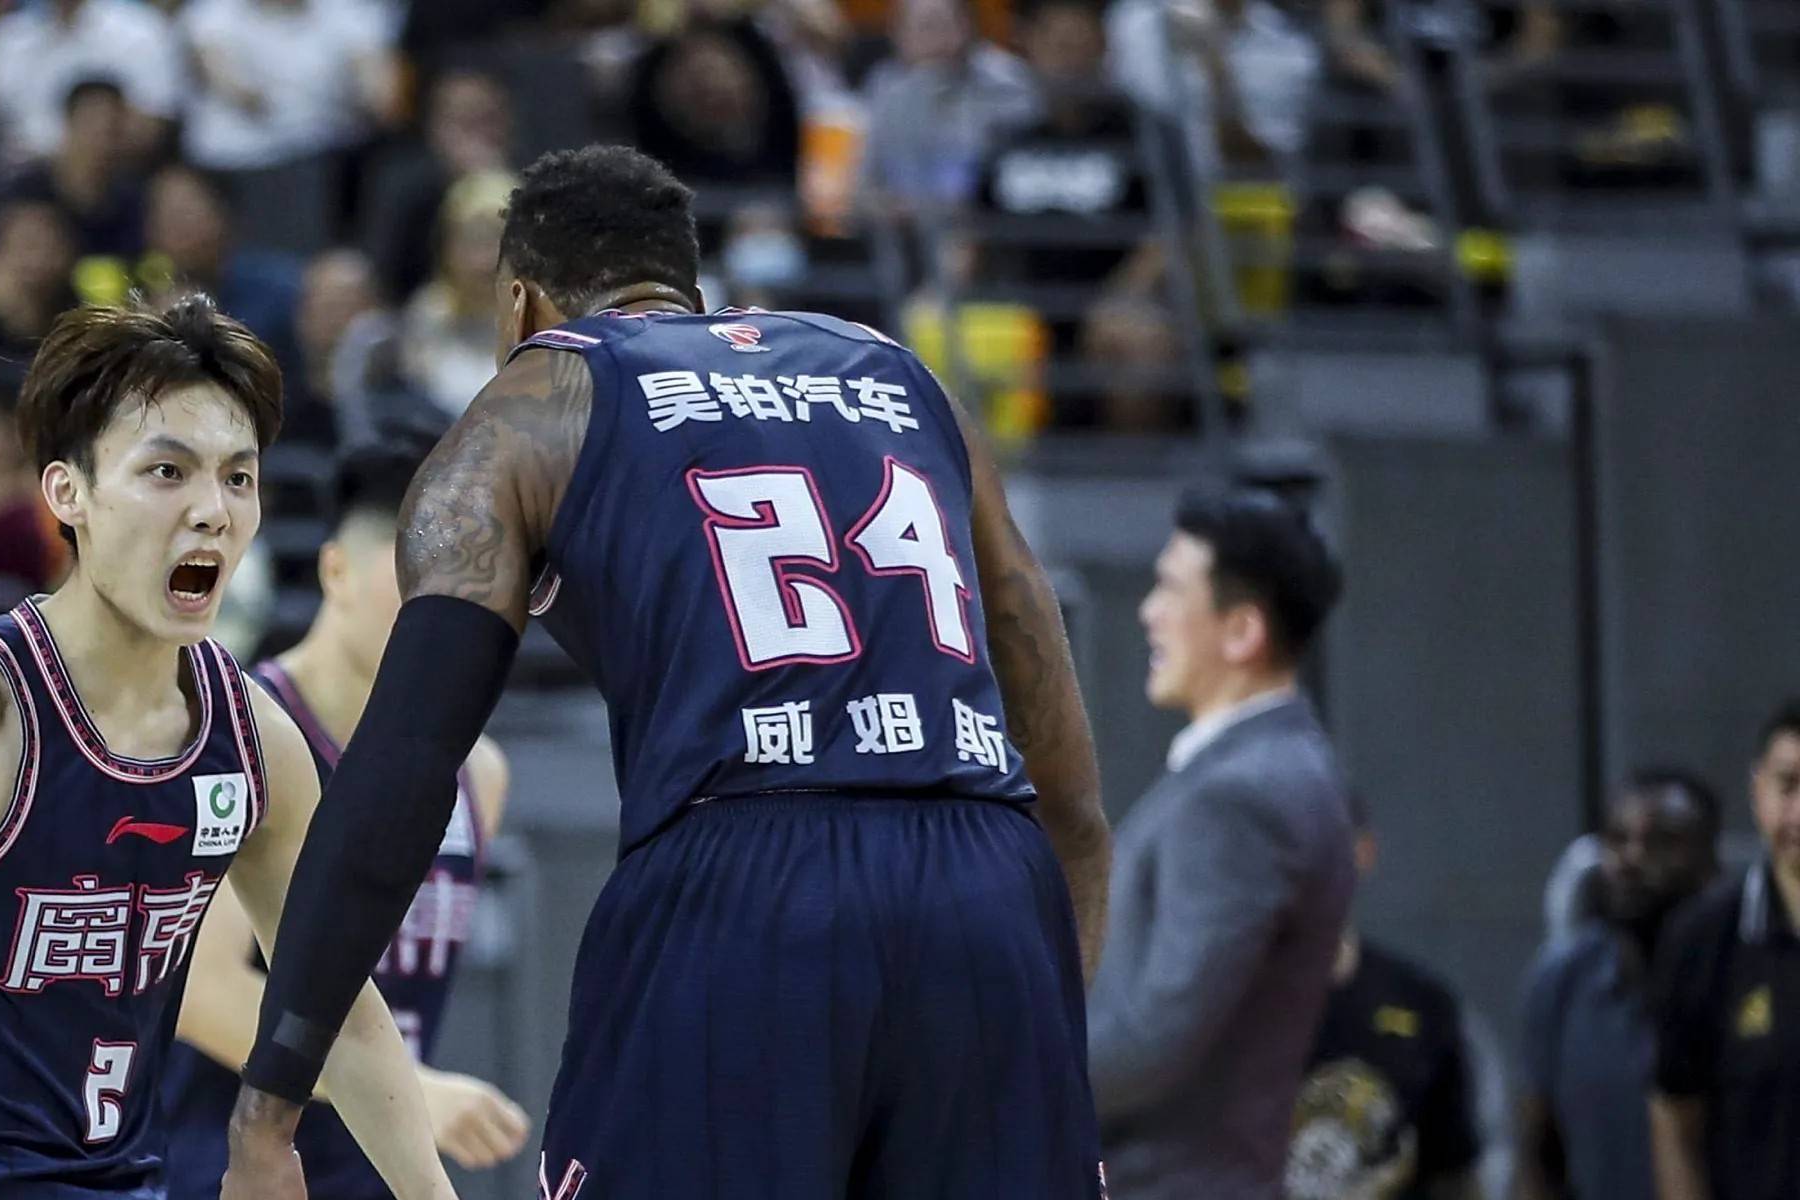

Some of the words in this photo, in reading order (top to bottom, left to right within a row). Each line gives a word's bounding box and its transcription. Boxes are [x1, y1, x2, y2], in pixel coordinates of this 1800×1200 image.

[636, 370, 920, 434] 昊铂汽车
[685, 455, 976, 672] 24
[740, 692, 1009, 775] 威姆斯
[83, 1038, 138, 1144] 2
